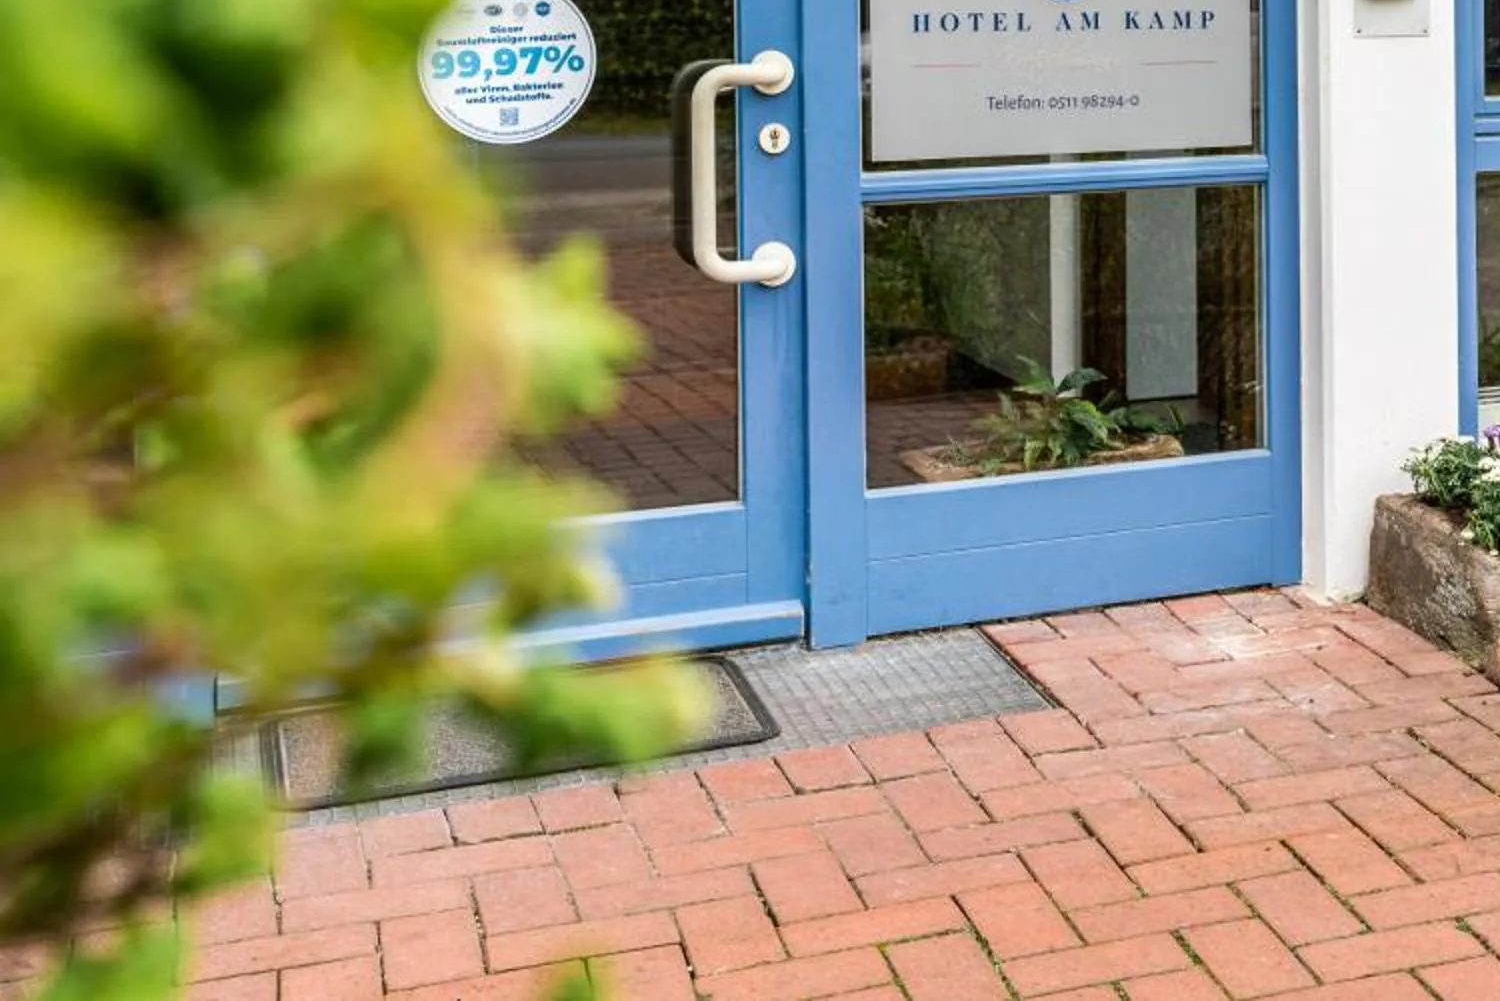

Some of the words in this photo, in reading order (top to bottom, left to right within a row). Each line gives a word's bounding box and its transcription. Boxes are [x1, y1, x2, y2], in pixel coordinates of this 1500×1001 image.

[912, 11, 1033, 34] HOTEL
[1055, 11, 1102, 31] AM
[1124, 9, 1217, 31] KAMP
[431, 44, 585, 82] 99,97%
[985, 94, 1046, 111] Telefon:
[1048, 95, 1079, 111] 0511
[1081, 93, 1140, 110] 98294-0
